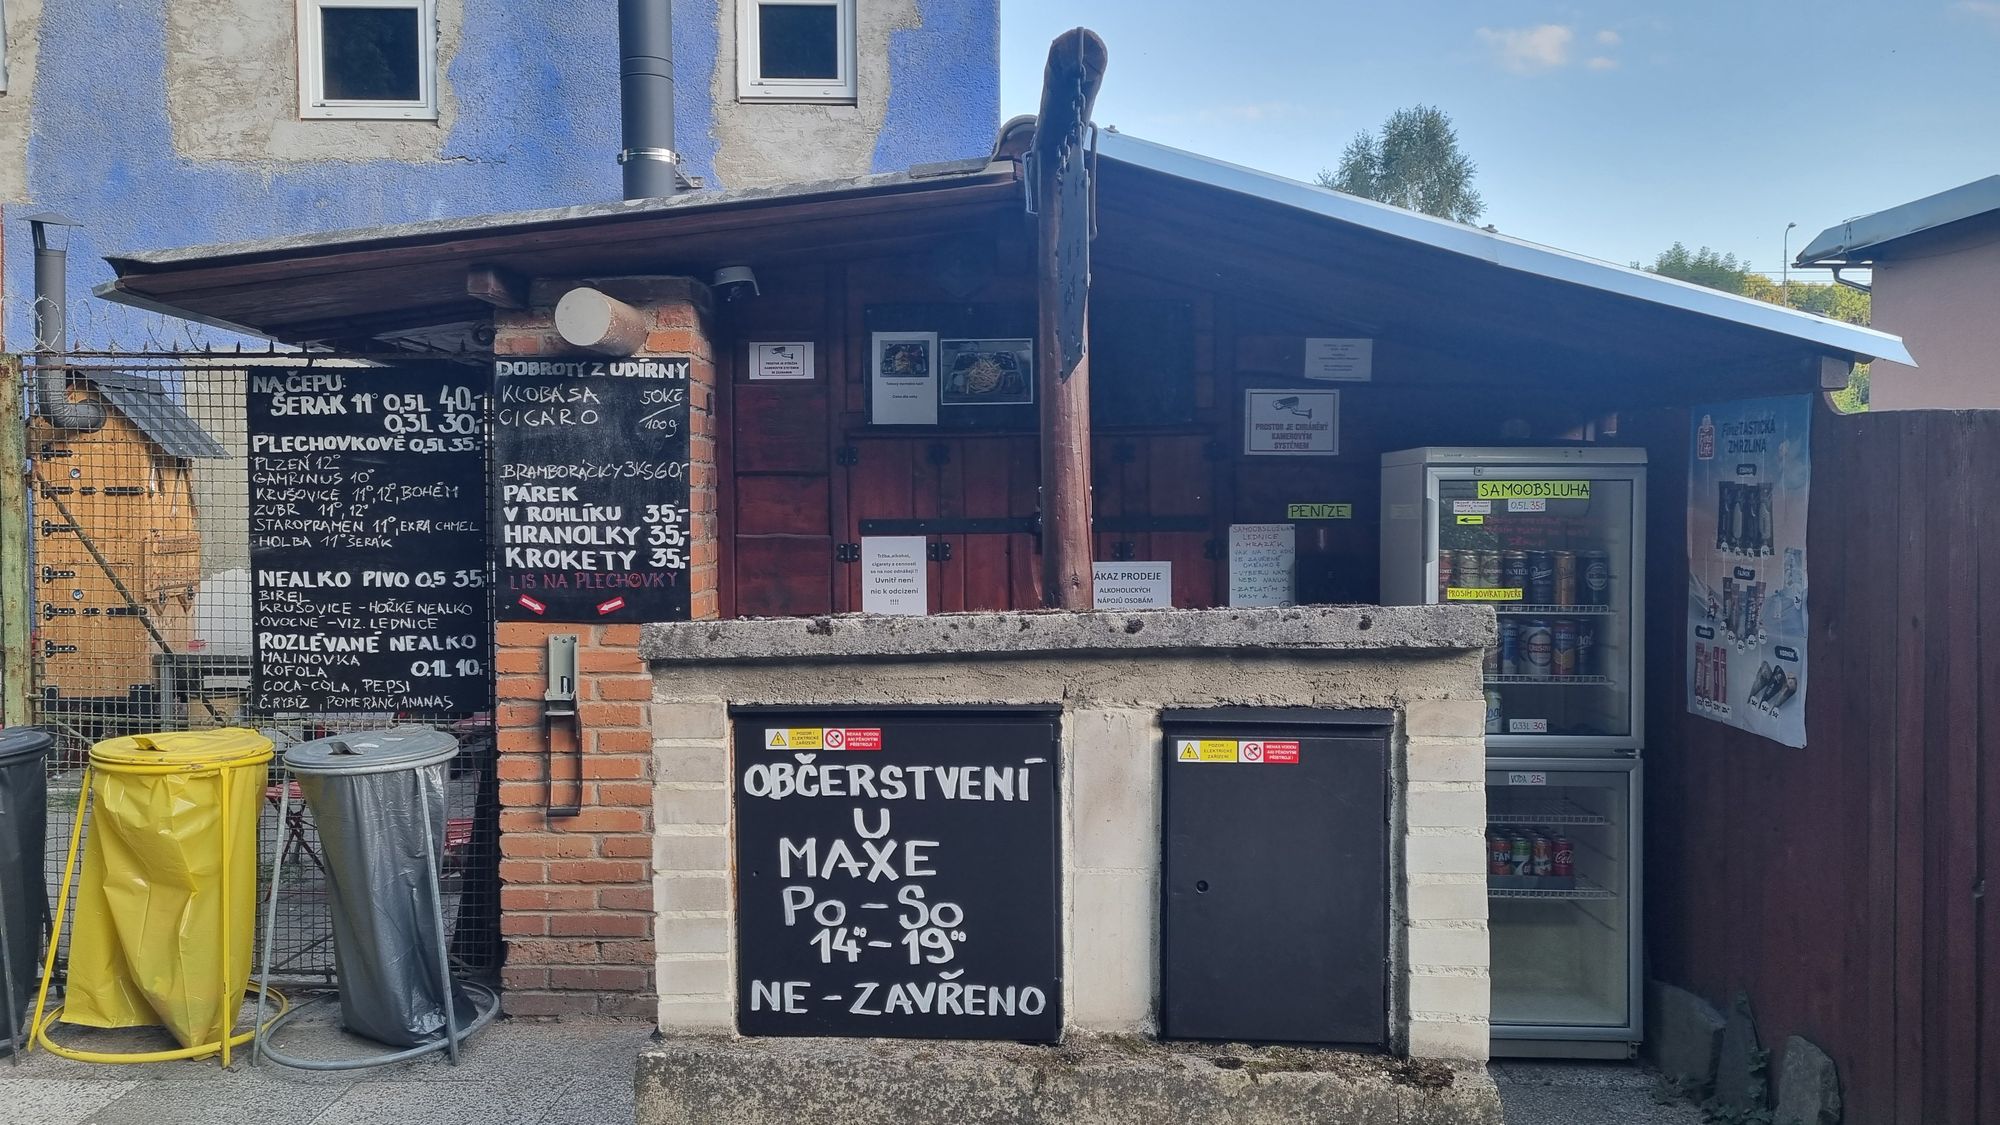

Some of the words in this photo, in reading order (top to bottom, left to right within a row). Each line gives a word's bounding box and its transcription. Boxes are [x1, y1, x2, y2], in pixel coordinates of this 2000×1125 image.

[496, 361, 586, 378] DOBROTY
[591, 363, 605, 376] Z
[610, 358, 688, 379] UDÍRNY
[253, 376, 283, 393] NA
[285, 371, 346, 393] ČEPU:
[271, 391, 347, 416] ŠERÁK
[350, 393, 378, 414] 11°
[500, 407, 598, 427] CIGÁRO
[252, 433, 405, 453] PLECHOVKOVÉ
[1728, 439, 1767, 453] ZMRZLINA
[255, 454, 312, 471] PLZEŇ
[316, 454, 341, 470] 12°
[500, 459, 623, 481] BRAMBORÁČKY
[351, 469, 375, 483] 10°
[256, 488, 341, 503] KRUŠOVICE
[401, 482, 459, 500] BOHÉM
[504, 483, 578, 504] PÁREK
[1481, 483, 1589, 497] SAMOOBSLUHA
[254, 504, 300, 516] ZUBR
[350, 504, 368, 517] 12°
[503, 506, 518, 522] V
[527, 503, 622, 522] ROHLÍKU
[1290, 505, 1348, 517] PENÍZE
[254, 519, 363, 533] STAROPRAMEN
[435, 520, 480, 533] CHMEL
[504, 524, 640, 546] HRANOLKY
[259, 536, 311, 548] HOLBA
[320, 534, 346, 547] 11°
[349, 533, 392, 548] ŠERÁK
[505, 547, 636, 570] KROKETY
[259, 570, 351, 588] NEALKO
[363, 571, 409, 588] PIVO
[510, 573, 536, 590] LIS
[544, 573, 568, 588] NA
[574, 572, 678, 589] PLECHOVKY
[1094, 571, 1118, 580] ÁKAZ
[259, 590, 310, 602] BIREL
[260, 602, 352, 616] KRUŠOVICE
[418, 603, 472, 616] NEALKO
[370, 618, 438, 629] LEDNICE
[259, 631, 382, 653] ROZLÉVANÉ
[390, 634, 476, 652] NEALKO
[261, 651, 360, 666] MALINOVKA
[263, 665, 328, 678] KOFOLA
[363, 680, 410, 693] PEPSI
[401, 695, 453, 711] ANANAS
[743, 752, 1047, 801] OBČERSTVENÍ
[1510, 775, 1527, 784] VODA
[853, 807, 890, 839] U
[779, 837, 940, 883] MAXE
[782, 885, 847, 927] Po
[897, 885, 964, 930] So
[750, 979, 811, 1014] NE
[849, 968, 1047, 1017] ZAVŘENO
